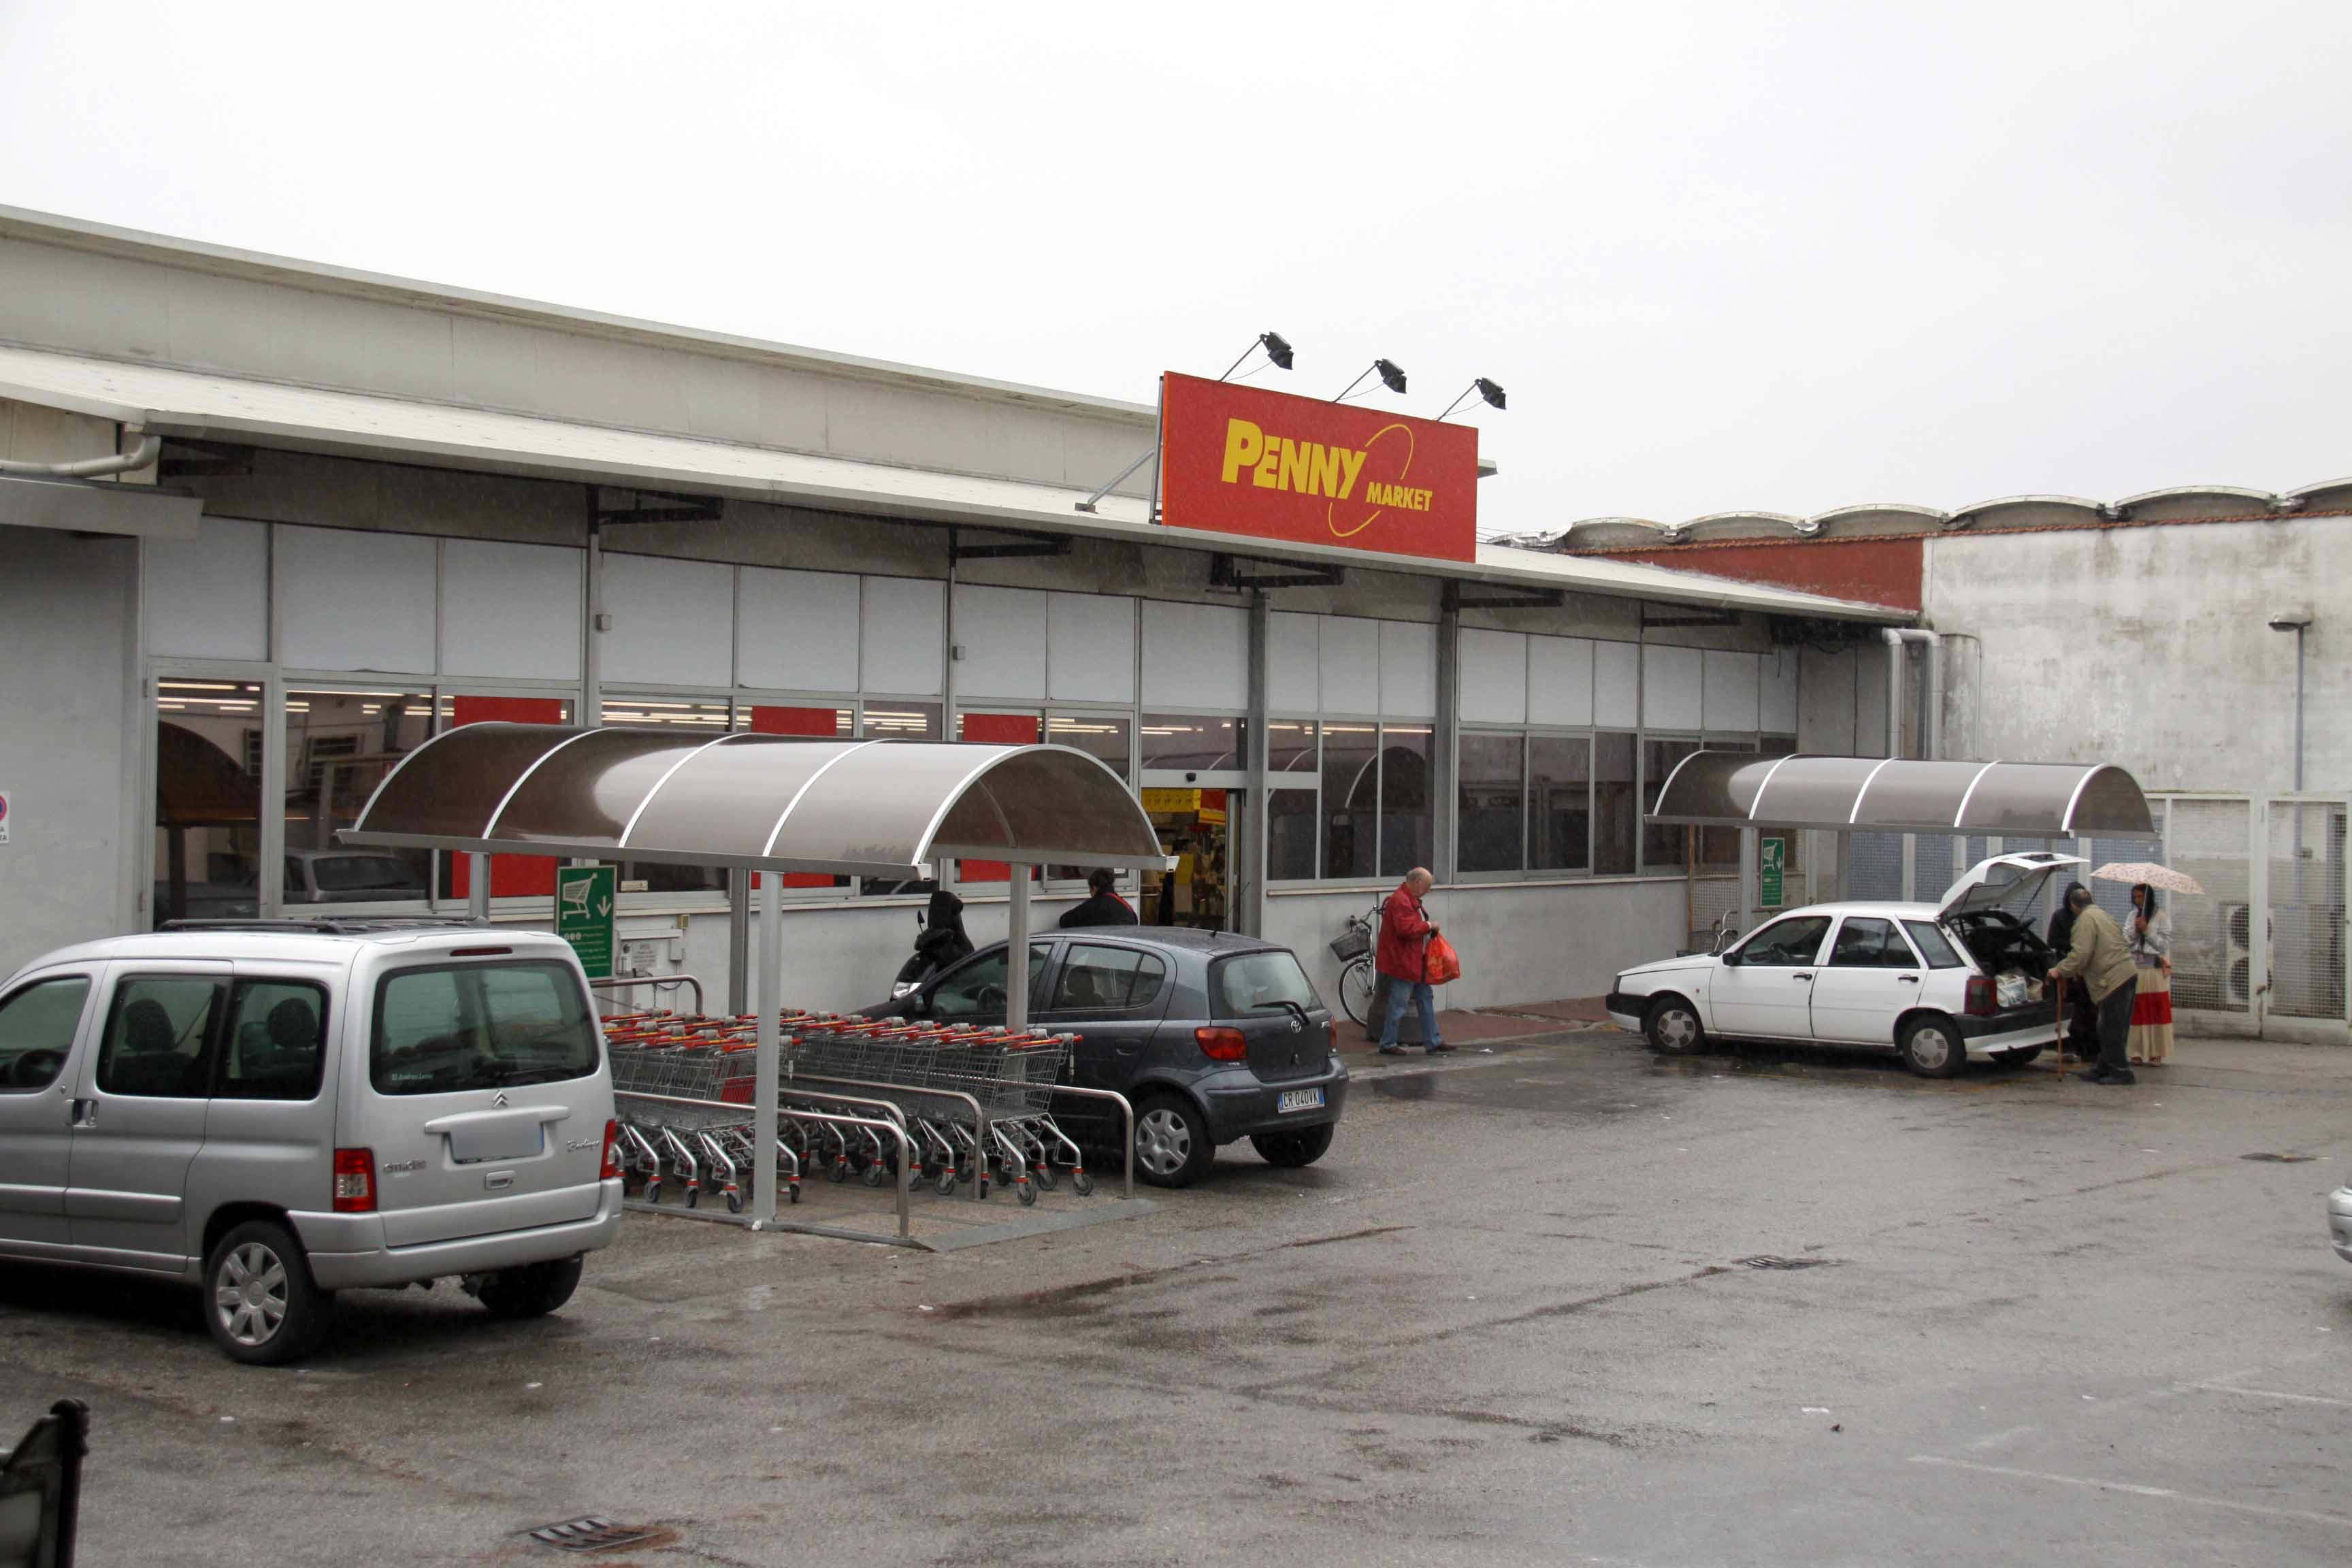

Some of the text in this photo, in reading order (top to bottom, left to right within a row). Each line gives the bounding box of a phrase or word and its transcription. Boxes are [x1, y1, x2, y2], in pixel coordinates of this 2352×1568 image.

[1222, 418, 1367, 500] PENNY
[1366, 481, 1433, 512] MARKET
[1284, 1094, 1293, 1107] CR
